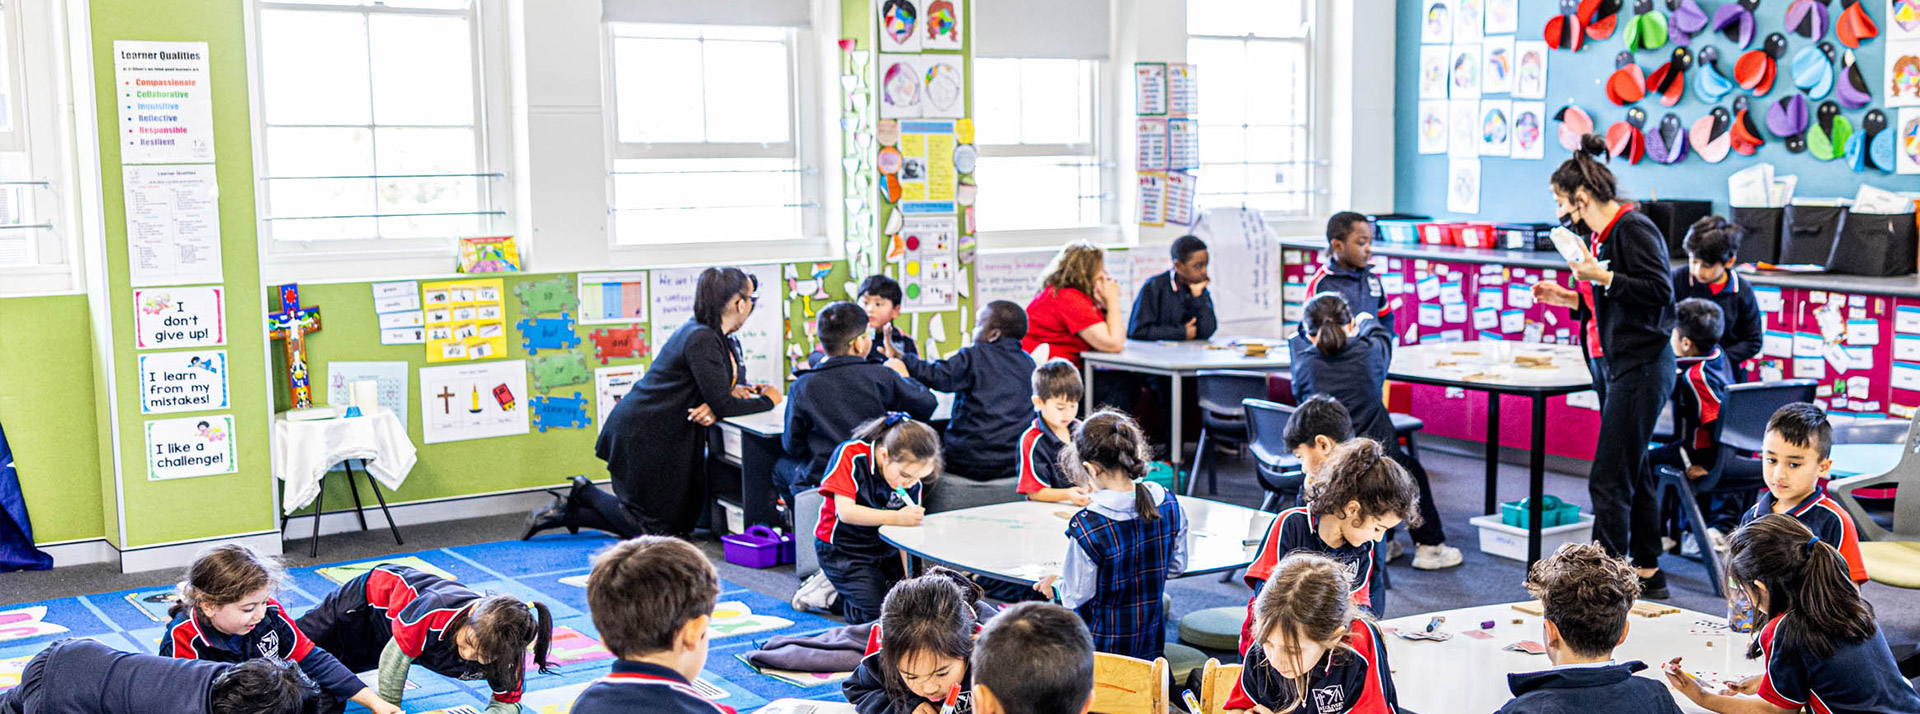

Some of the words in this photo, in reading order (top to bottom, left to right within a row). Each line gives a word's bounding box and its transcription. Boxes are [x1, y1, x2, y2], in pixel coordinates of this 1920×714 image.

[121, 51, 157, 60] Learner
[159, 51, 200, 61] Qualities
[136, 79, 196, 87] Compassionate
[136, 90, 189, 98] Collaborative
[138, 103, 179, 111] Inquisitive
[140, 138, 175, 146] Resilient
[177, 302, 184, 312] I
[164, 315, 198, 327] don't
[155, 330, 184, 343] give
[189, 328, 208, 341] up!
[149, 372, 156, 382] I
[164, 371, 197, 381] learn
[150, 384, 183, 395] from
[191, 384, 210, 393] my
[151, 394, 210, 407] mistakes!
[156, 443, 163, 454] I
[168, 442, 191, 454] like
[196, 443, 204, 451] a
[157, 453, 223, 468] challenge!
